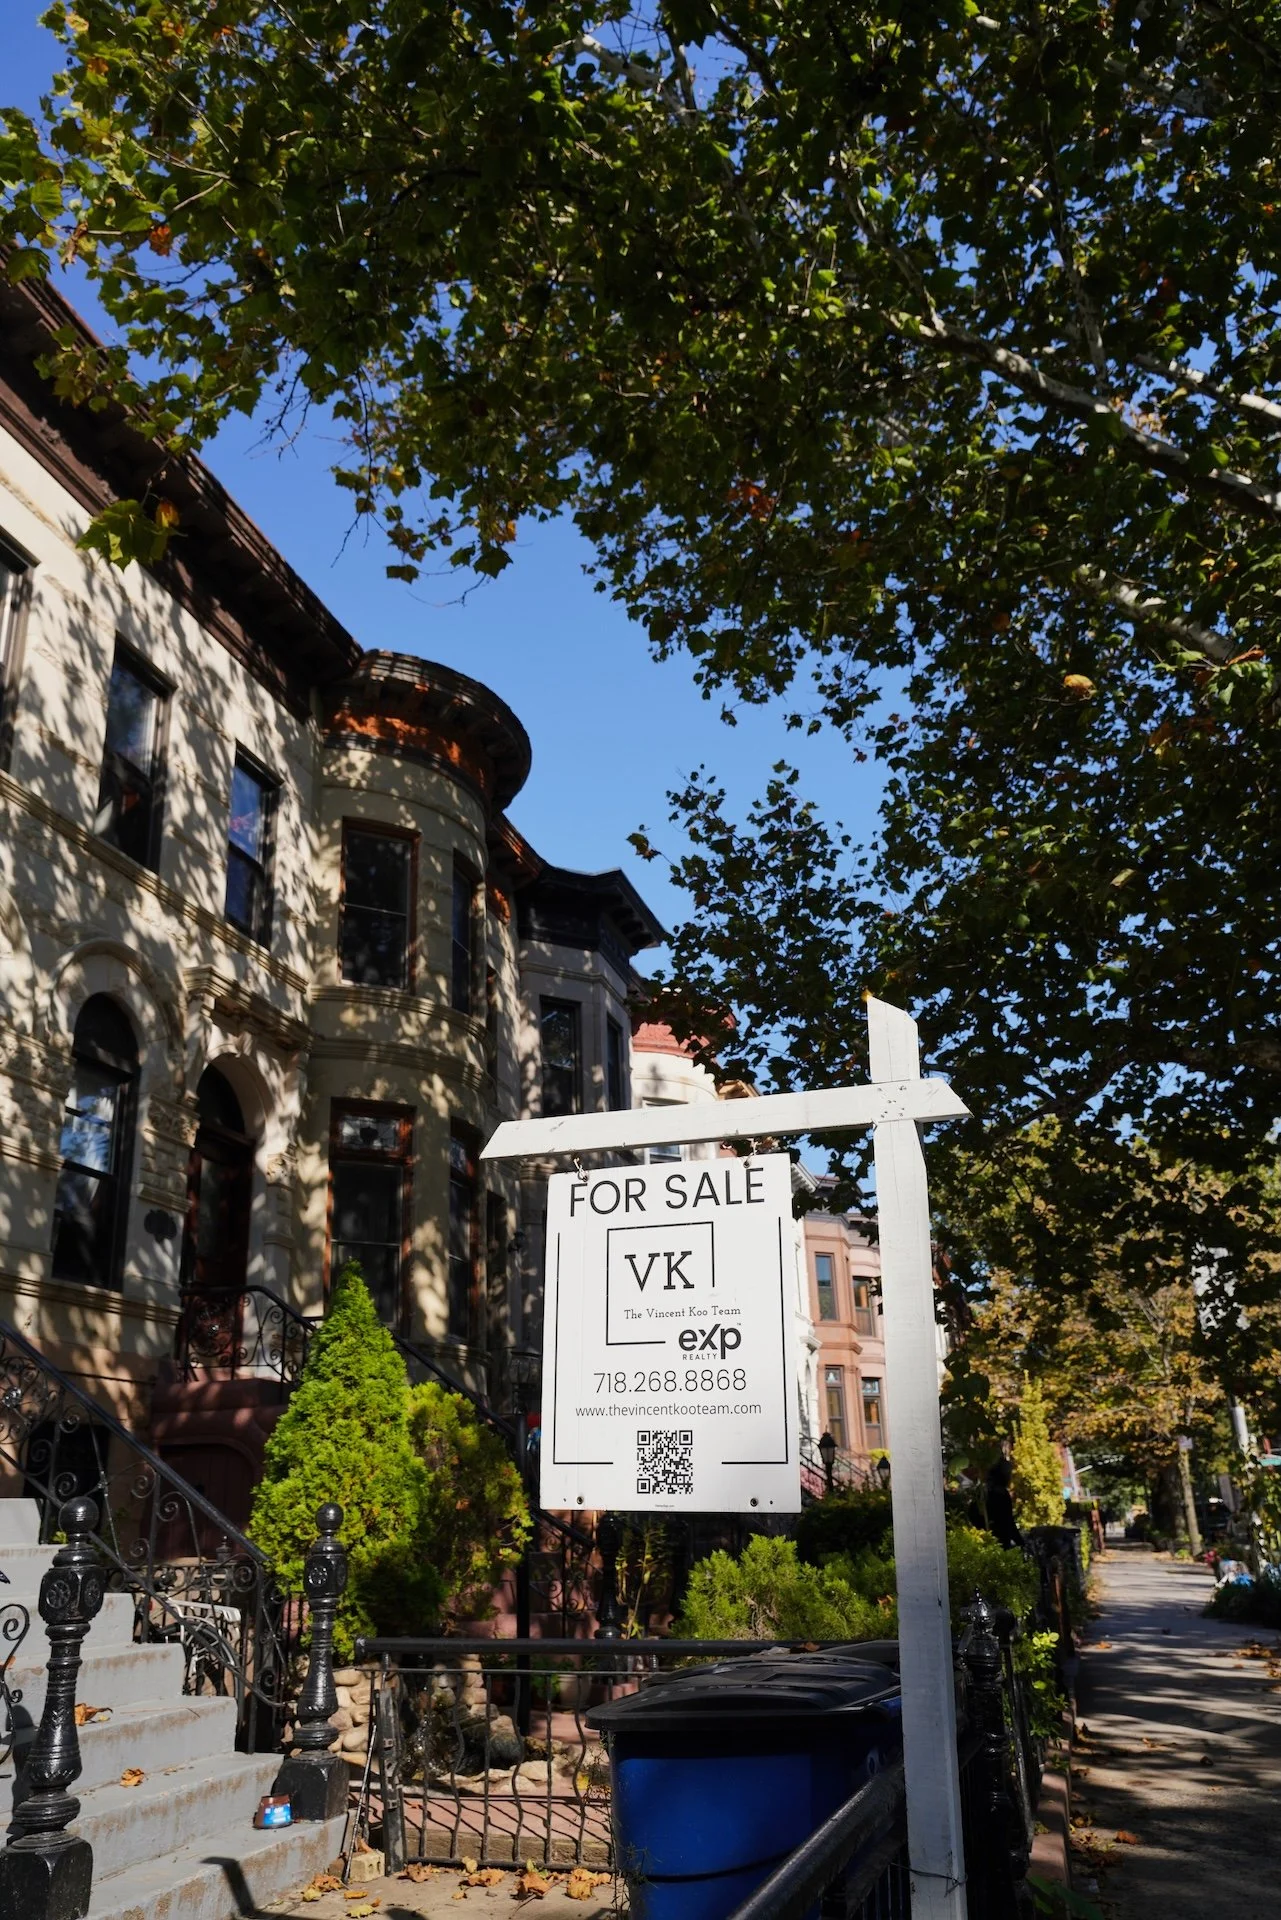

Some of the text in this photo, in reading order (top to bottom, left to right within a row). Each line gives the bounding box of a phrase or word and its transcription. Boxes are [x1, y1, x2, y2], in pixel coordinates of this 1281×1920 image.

[570, 1167, 764, 1218] FOR SALE
[624, 1251, 695, 1292] VK
[624, 1305, 741, 1320] The Vincent Koo Team
[682, 1353, 718, 1361] REALTY
[593, 1368, 747, 1394] 718.268.8868
[575, 1402, 762, 1417] www.thevincentkooteam.com
